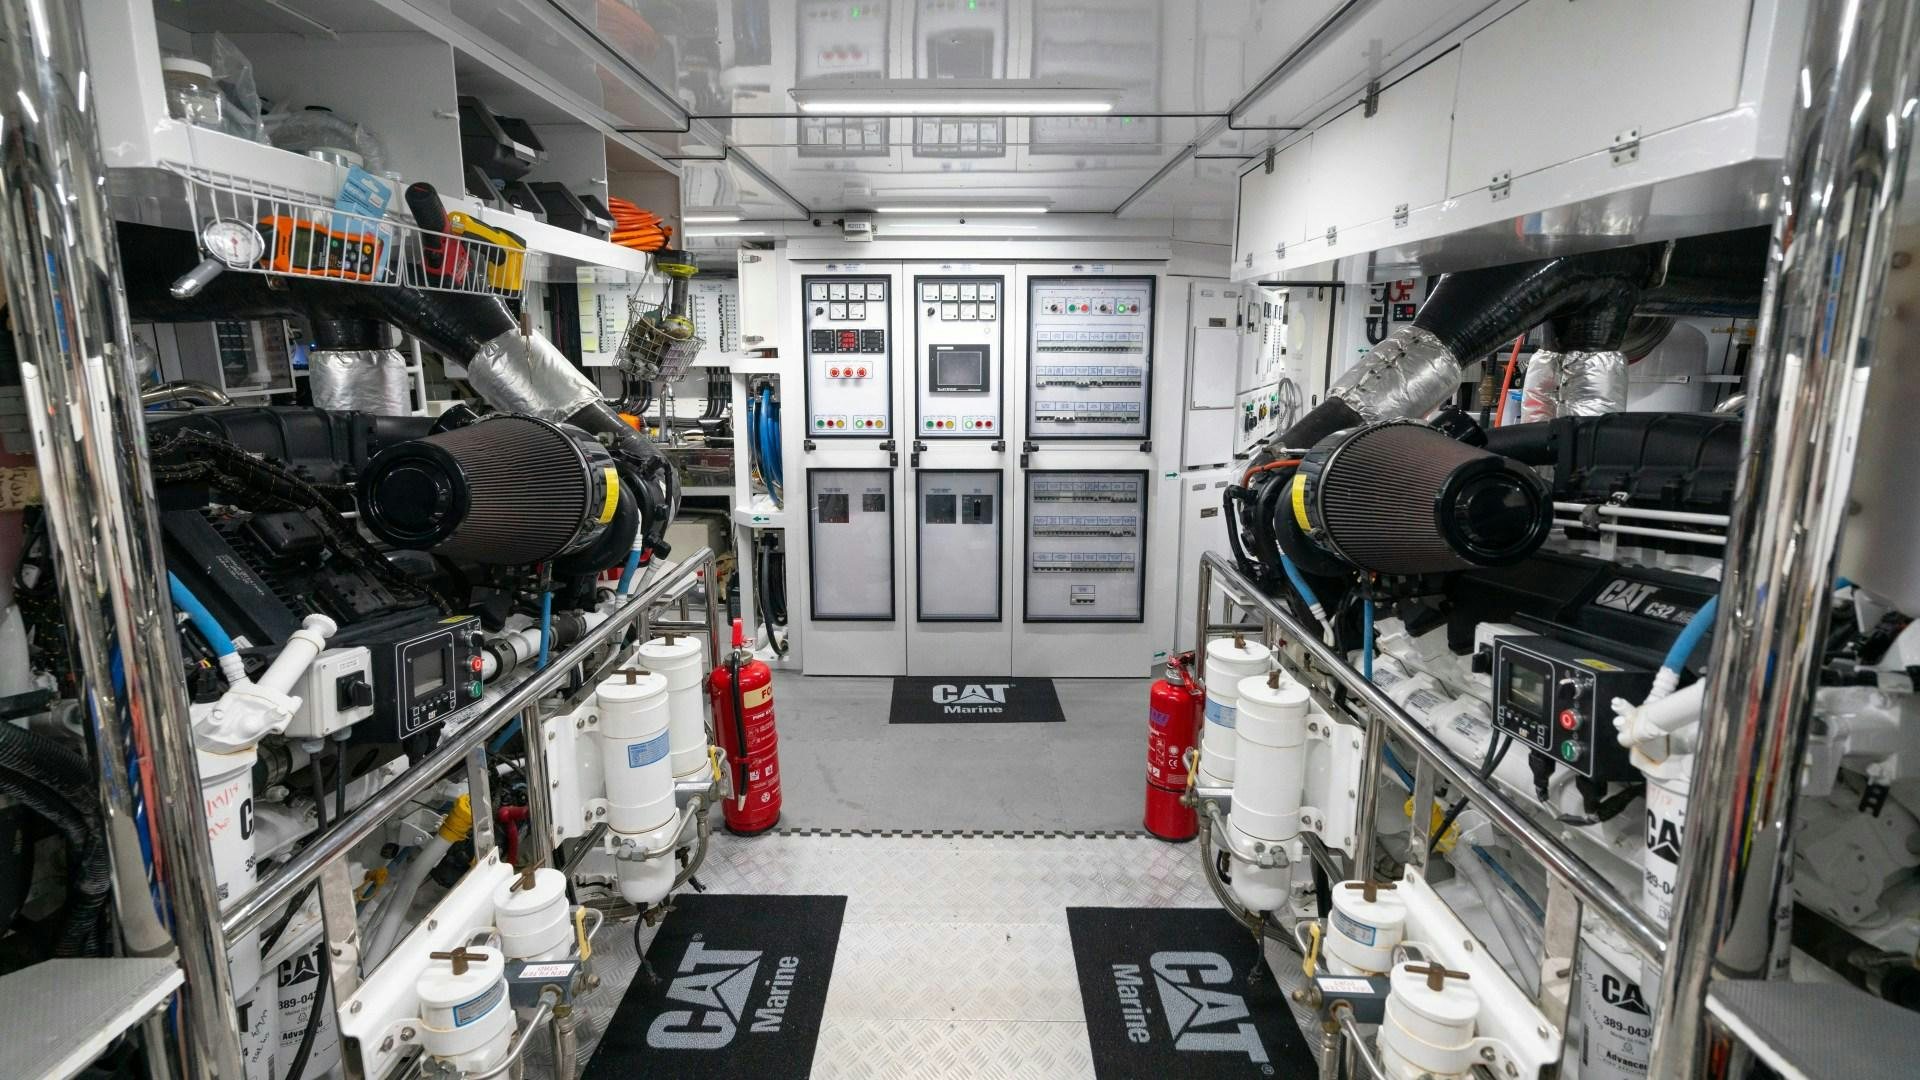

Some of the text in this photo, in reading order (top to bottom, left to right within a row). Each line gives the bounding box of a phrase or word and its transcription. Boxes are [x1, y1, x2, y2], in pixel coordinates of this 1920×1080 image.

[1595, 579, 1659, 613] CAT
[1643, 602, 1676, 619] C32
[932, 684, 1010, 704] CAT
[943, 705, 1003, 714] Marine
[646, 941, 764, 1050] CAT
[750, 956, 799, 1033] Marine
[1111, 963, 1152, 1044] Marine
[1150, 950, 1270, 1064] CAT
[1602, 974, 1651, 1017] CA
